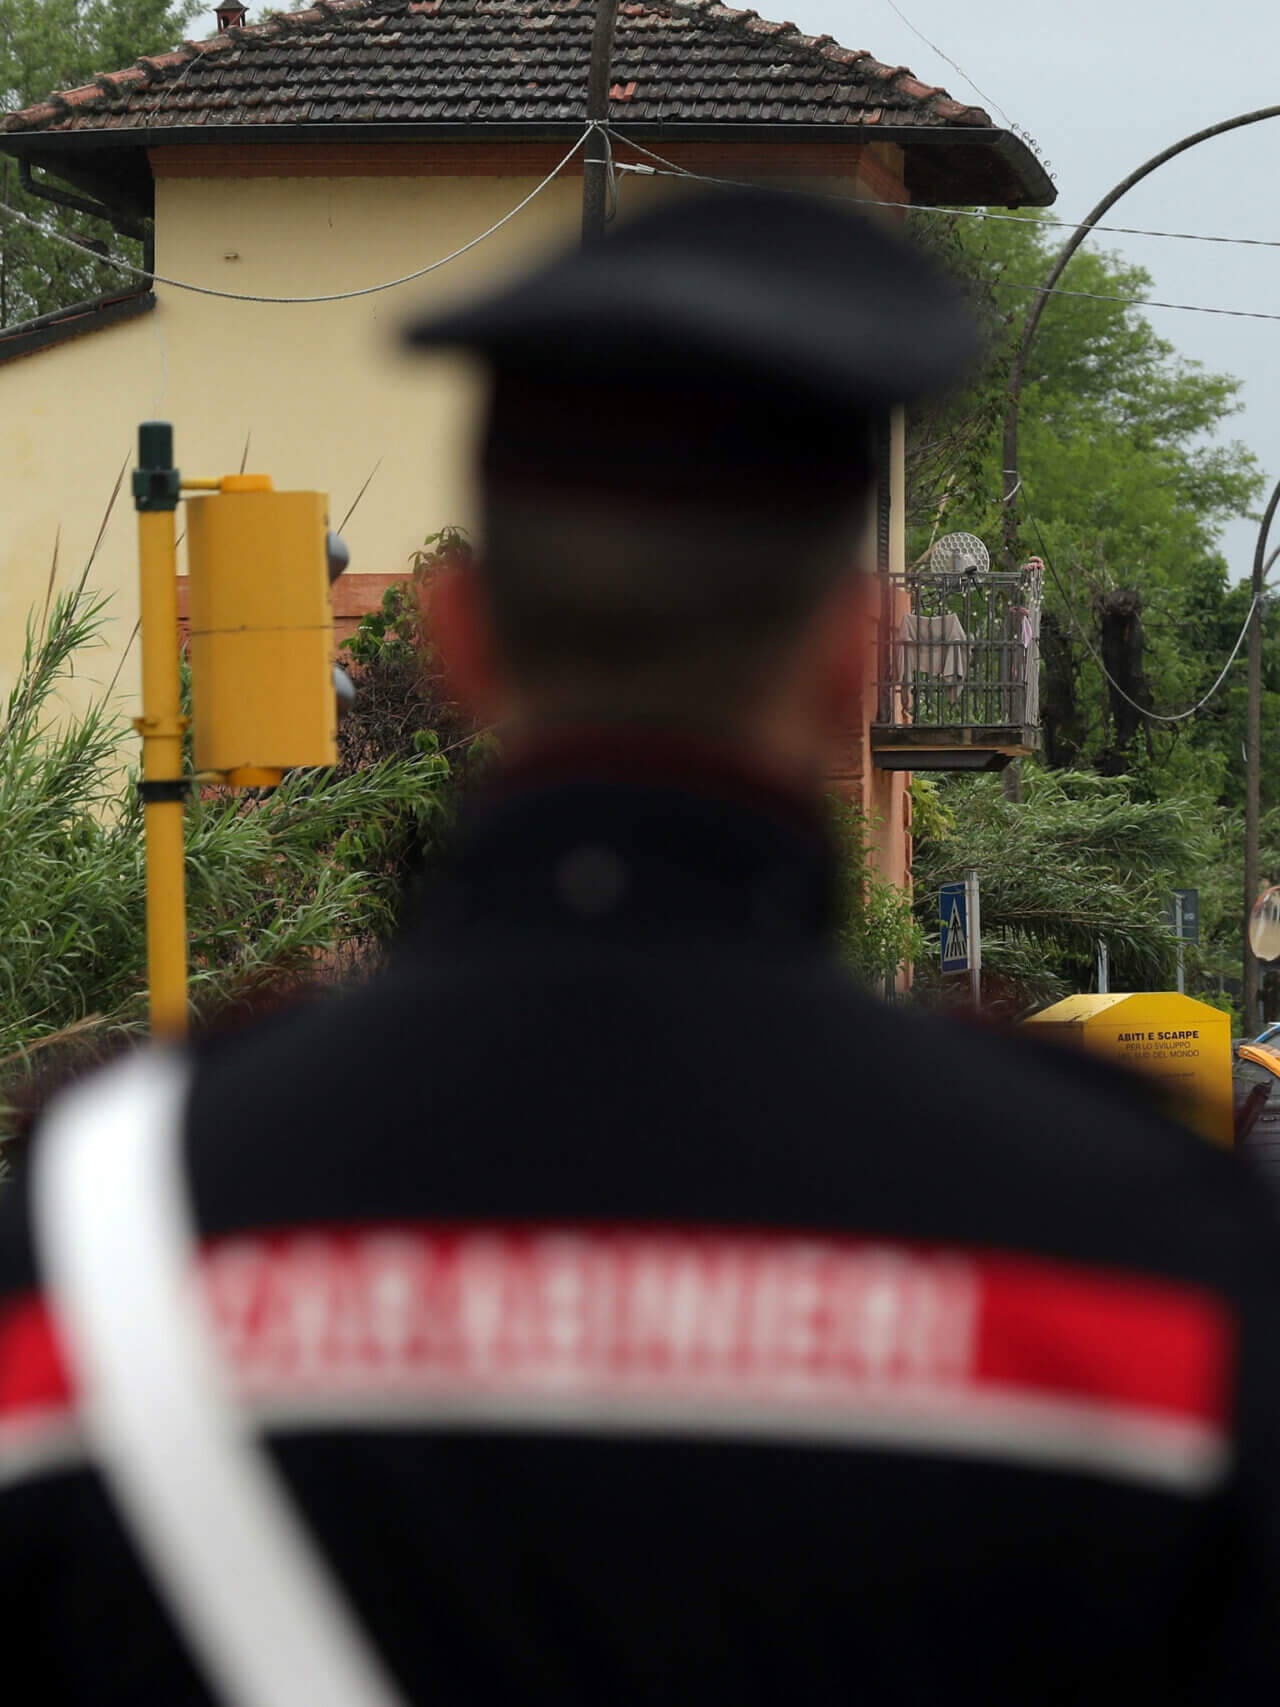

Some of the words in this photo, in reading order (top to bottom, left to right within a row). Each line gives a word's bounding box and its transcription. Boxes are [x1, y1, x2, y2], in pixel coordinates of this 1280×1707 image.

[1118, 1033, 1144, 1041] ABITI
[1148, 1032, 1154, 1040] E
[1158, 1030, 1199, 1040] SCARPE
[1154, 1041, 1191, 1049] SVILUPPO
[1170, 1049, 1199, 1057] MONDO
